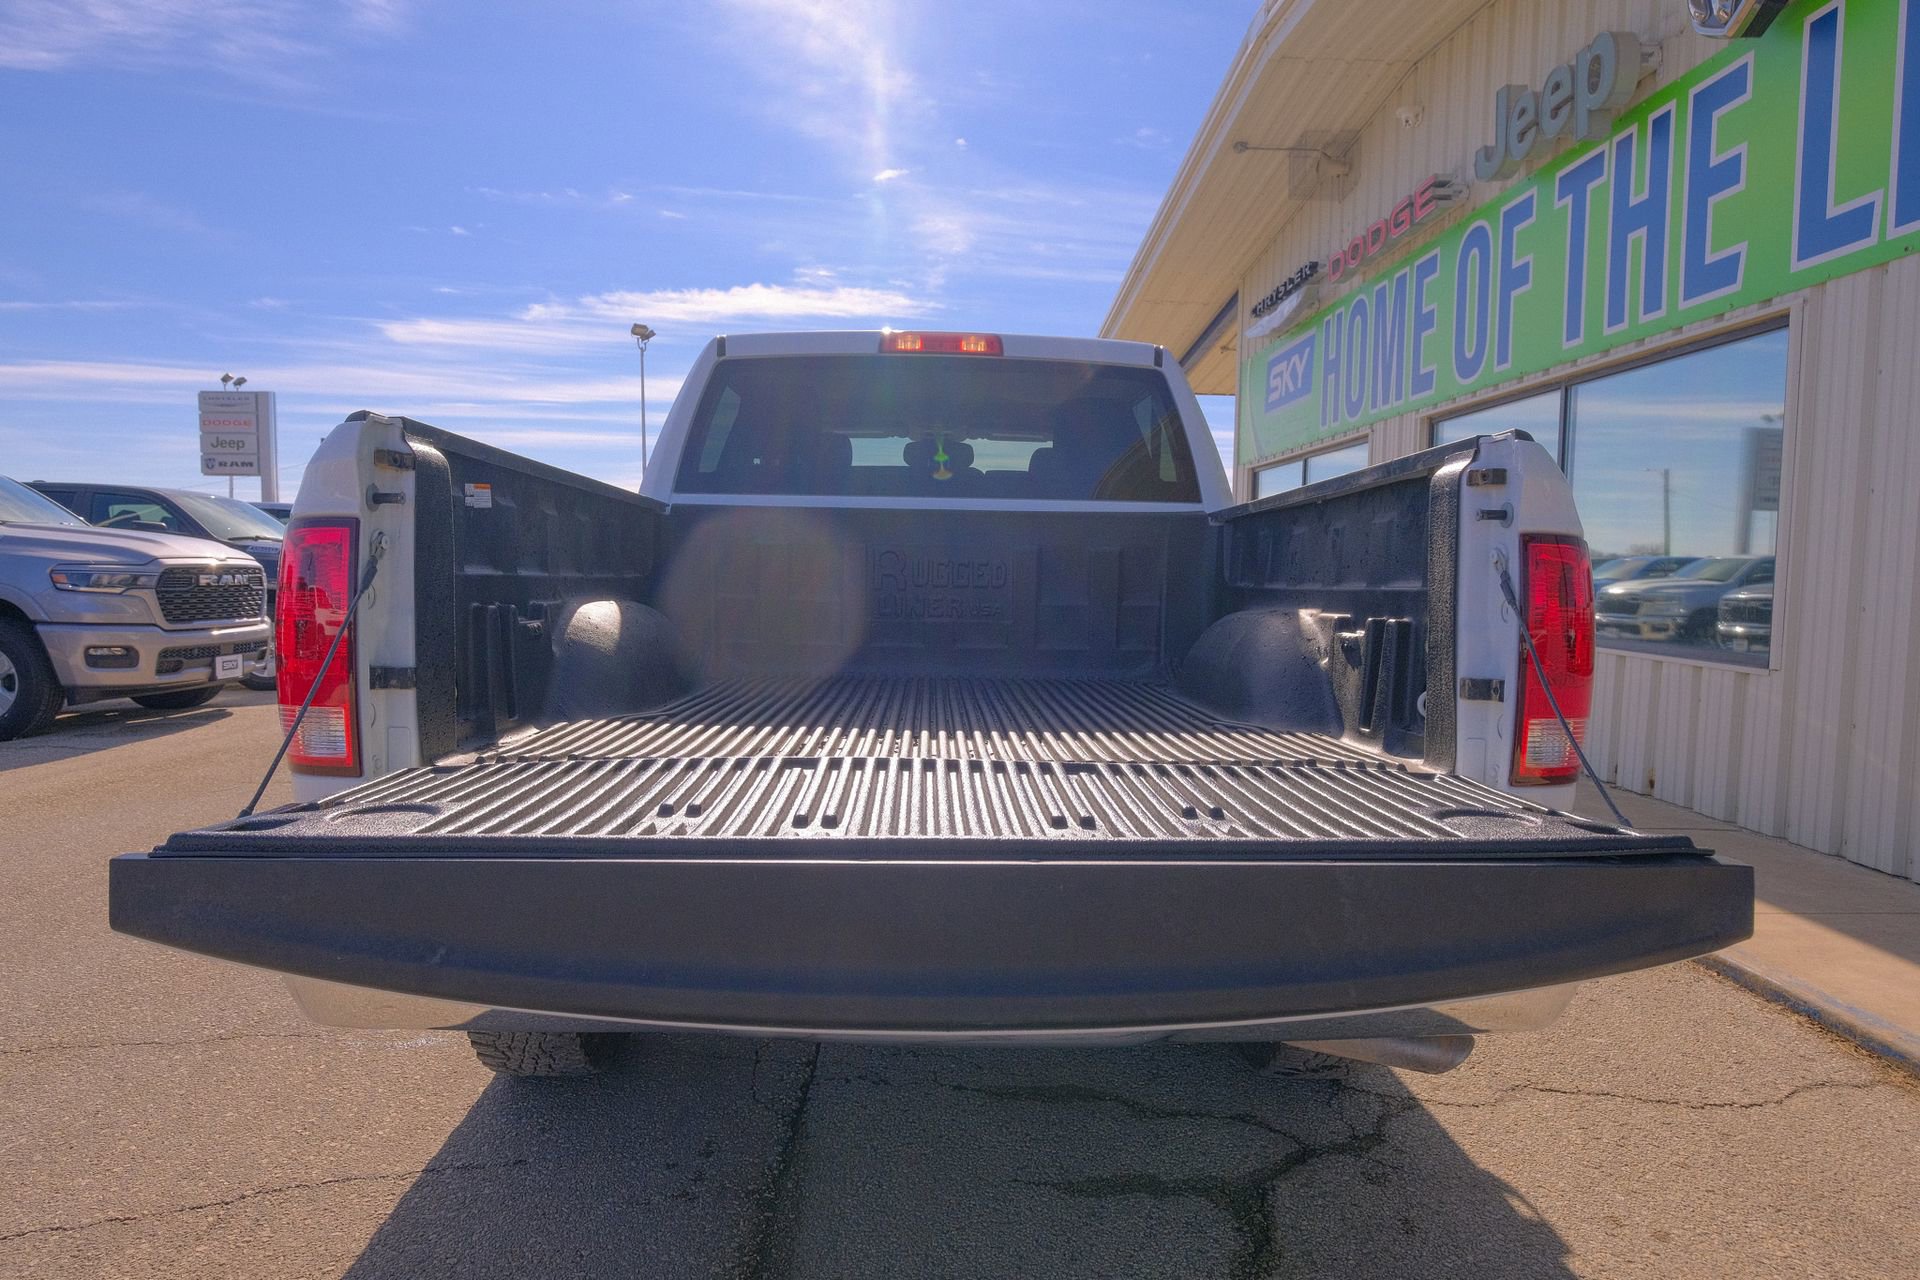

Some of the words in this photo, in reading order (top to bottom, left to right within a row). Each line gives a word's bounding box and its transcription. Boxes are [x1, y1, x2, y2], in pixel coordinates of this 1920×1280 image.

[1474, 31, 1622, 183] Jeep
[1319, 246, 1441, 431] HOME
[1452, 186, 1538, 386] OF
[1554, 50, 1755, 350] THE
[1790, 0, 1920, 273] L
[1328, 176, 1438, 283] DODGE
[1267, 344, 1312, 404] SKY
[210, 436, 246, 451] Jeep
[199, 574, 249, 586] RAM
[872, 549, 1008, 591] RUGGED
[222, 660, 238, 671] SKY
